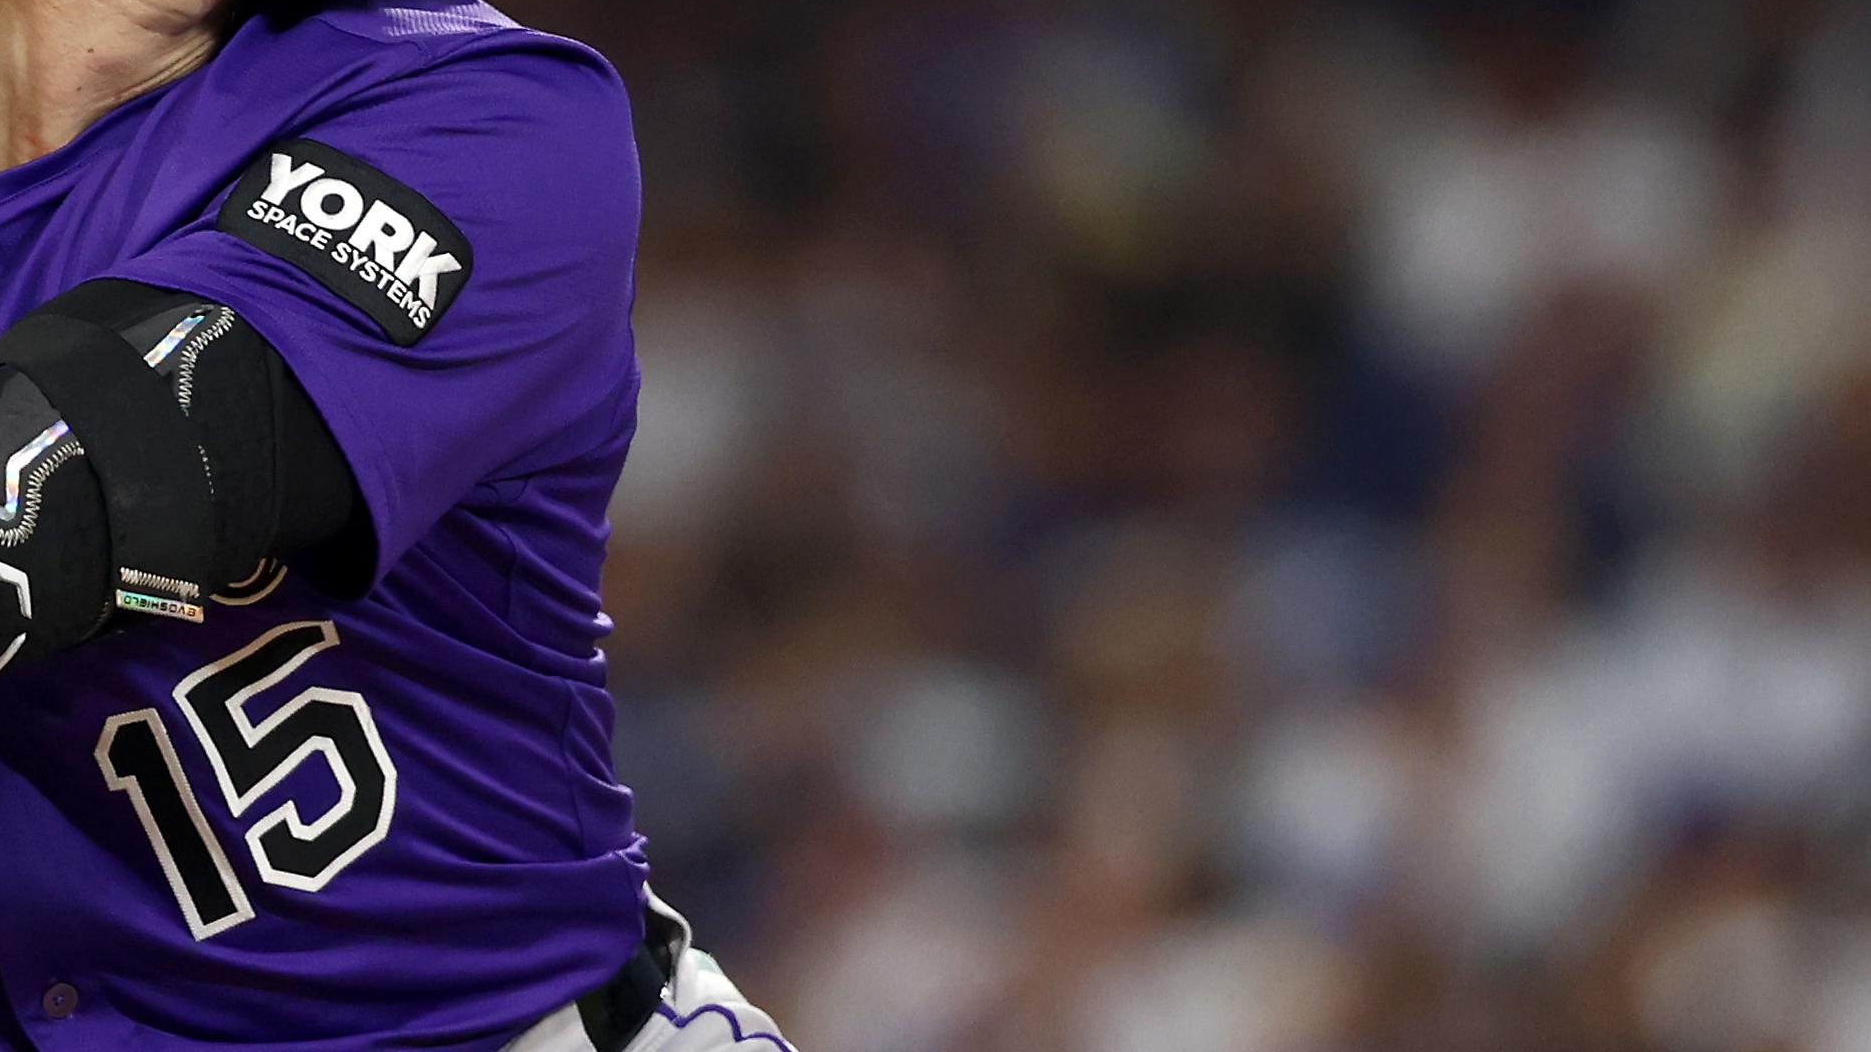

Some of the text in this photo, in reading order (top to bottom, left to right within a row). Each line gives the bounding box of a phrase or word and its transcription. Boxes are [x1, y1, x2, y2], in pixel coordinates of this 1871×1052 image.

[247, 201, 431, 329] SPACE SYSTEMS
[260, 152, 462, 310] YORK
[123, 595, 196, 617] EVOSHIELD
[94, 620, 398, 942] 15
